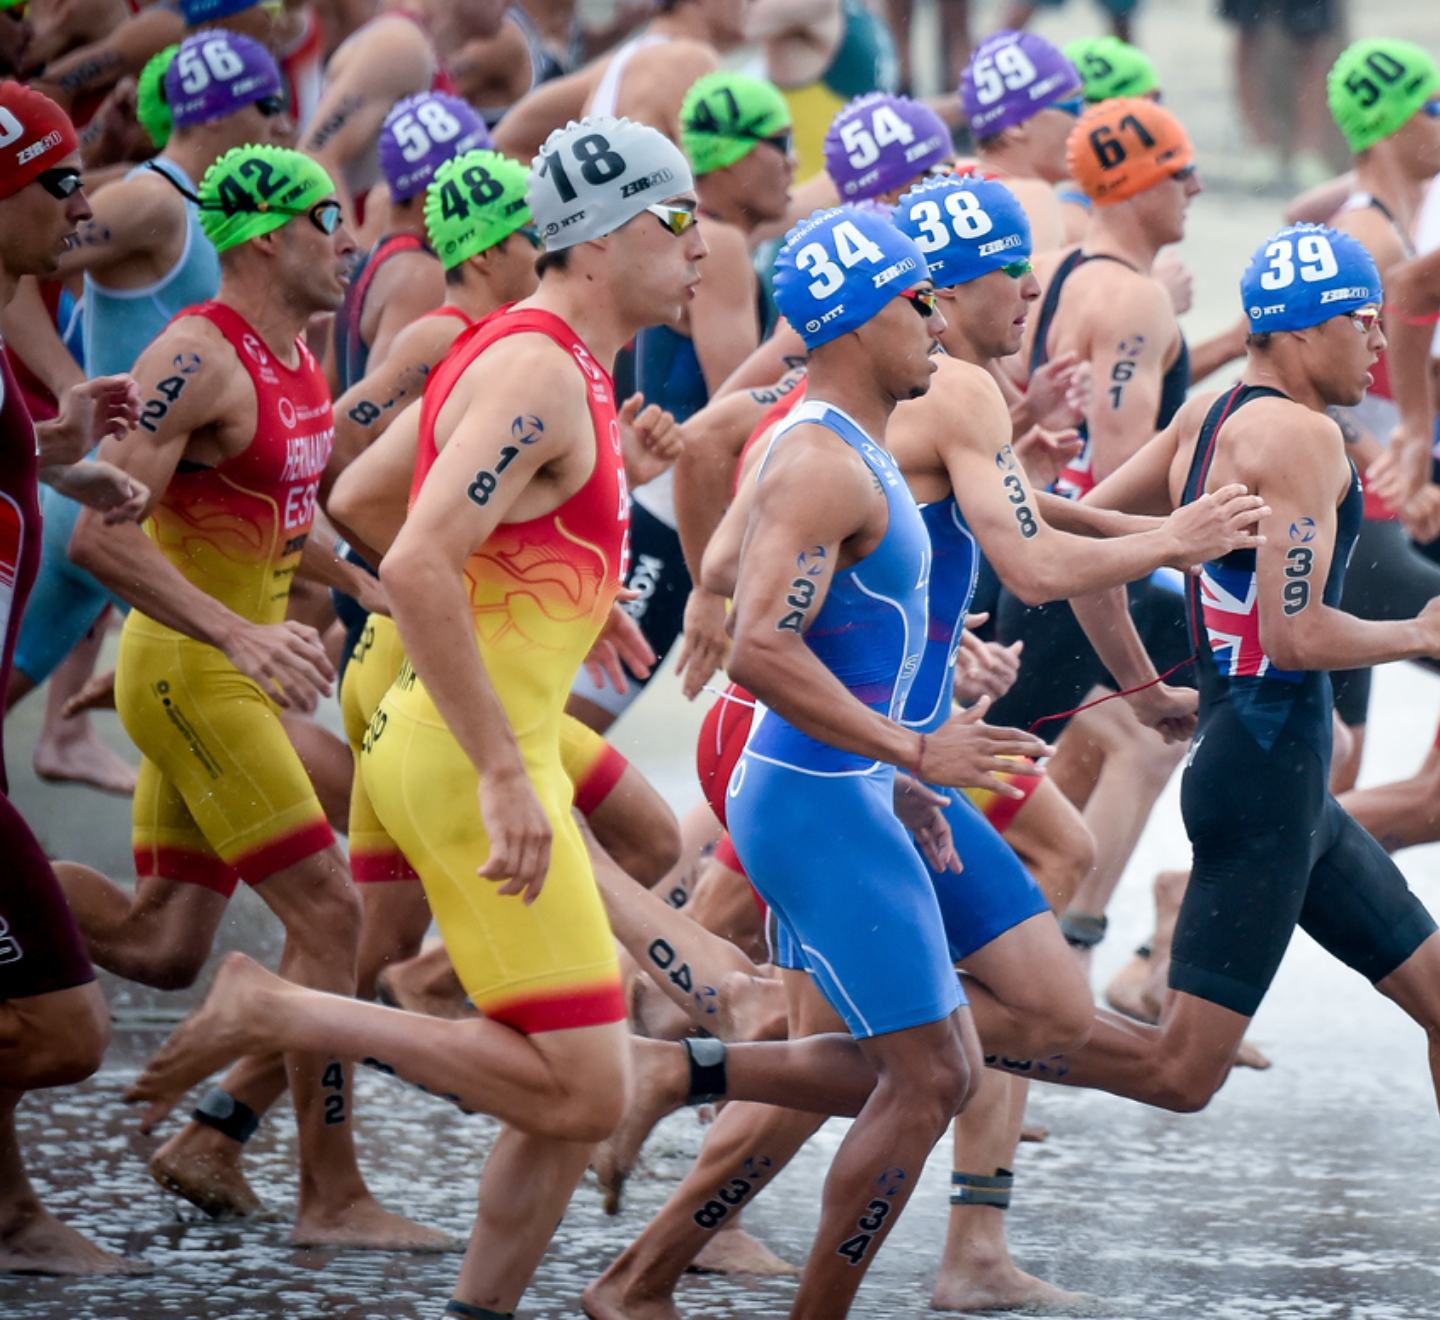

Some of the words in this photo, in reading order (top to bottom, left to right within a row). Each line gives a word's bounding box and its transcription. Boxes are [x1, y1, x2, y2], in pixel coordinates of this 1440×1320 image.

[178, 40, 244, 95] 56
[973, 45, 1037, 105] 59
[1344, 52, 1406, 107] 50
[390, 101, 461, 162] 58
[840, 105, 914, 170] 54
[1090, 115, 1156, 170] 61
[217, 158, 290, 218] 42
[439, 166, 504, 221] 48
[539, 132, 627, 204] 18
[910, 191, 993, 254] 38
[795, 221, 886, 300] 34
[1260, 235, 1339, 291] 39
[1109, 359, 1137, 411] 61
[465, 444, 520, 508] 18
[1003, 473, 1038, 540] 38
[775, 576, 817, 635] 34
[1282, 545, 1314, 618] 39
[320, 1061, 346, 1126] 42
[837, 1198, 891, 1266] 34
